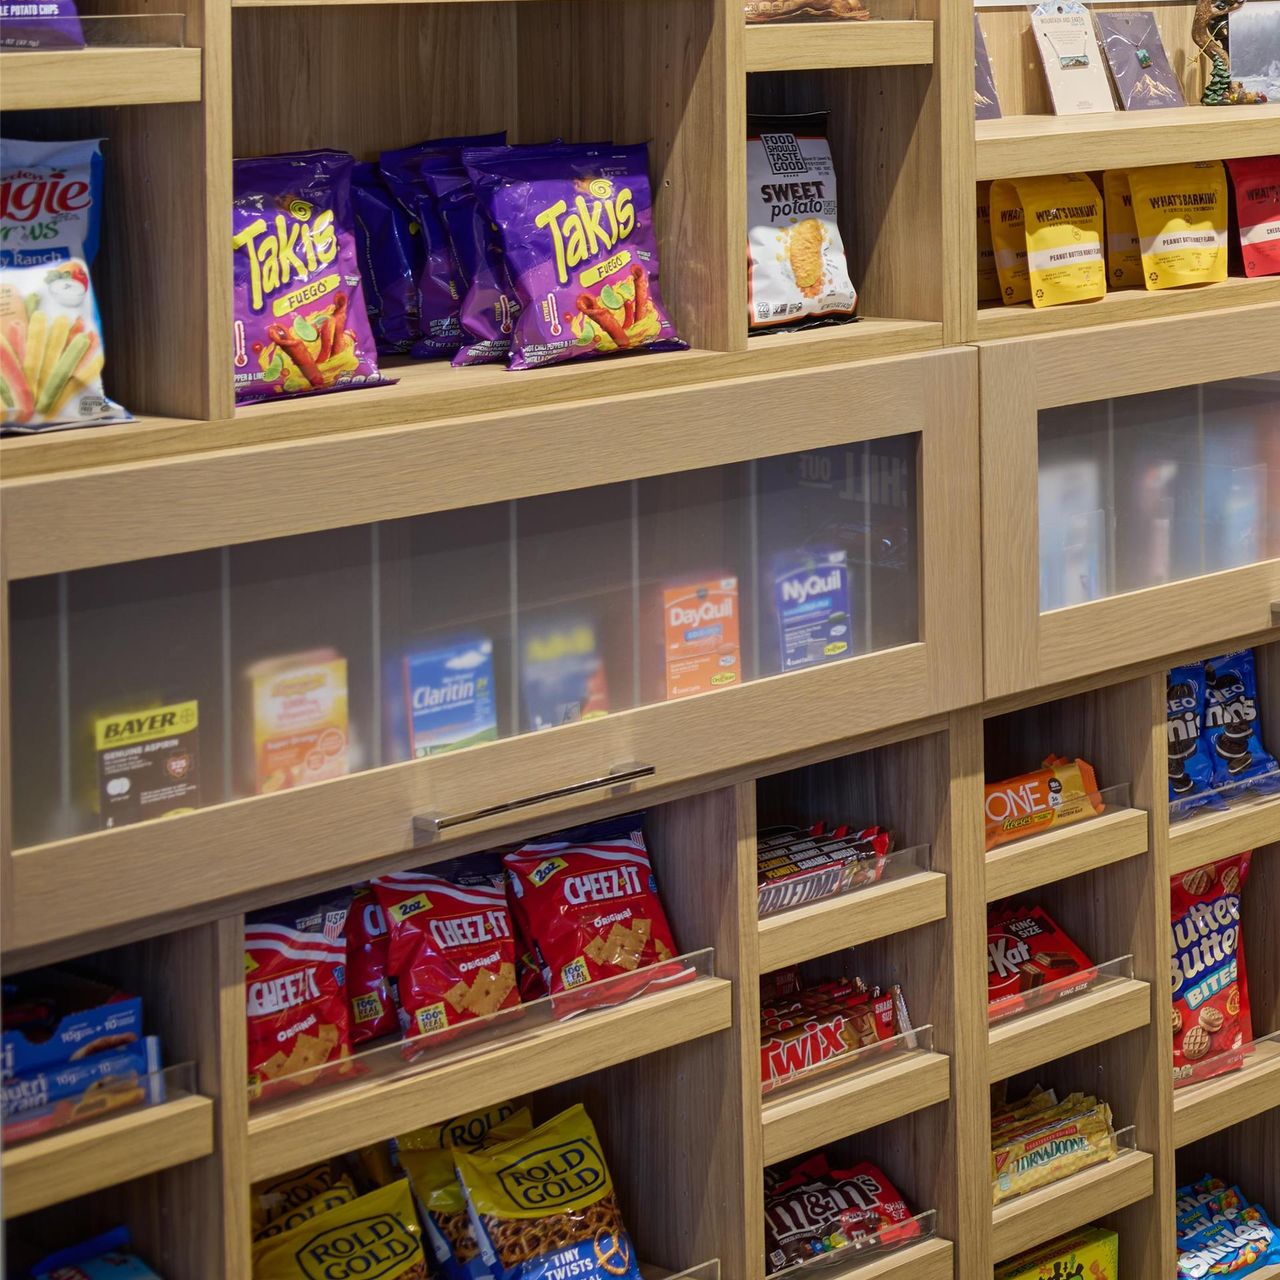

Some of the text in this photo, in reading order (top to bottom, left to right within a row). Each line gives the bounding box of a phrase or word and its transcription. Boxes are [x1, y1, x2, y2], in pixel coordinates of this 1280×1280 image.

[10, 4, 59, 17] POTATO CHIPS
[764, 135, 795, 146] FOOD
[767, 144, 798, 153] SHOULD
[770, 152, 801, 162] TASTE
[773, 161, 806, 172] GOOD
[760, 180, 826, 204] SWEET
[771, 198, 823, 222] potato
[533, 187, 637, 283] Takis
[1162, 236, 1181, 246] PEANUT
[13, 251, 62, 266] Ranch
[231, 209, 338, 310] Takis
[596, 257, 624, 280] FUEGO
[1050, 252, 1068, 262] PEANUT
[286, 282, 327, 309] FUEGO
[782, 571, 842, 603] NyQuil
[670, 599, 734, 627] DayQuil
[412, 681, 475, 711] Claritin
[104, 711, 176, 741] BAYER
[103, 738, 179, 761] GENUINE ASPIRIN
[985, 780, 1047, 822] ONE
[325, 910, 346, 922] USA
[1009, 918, 1036, 933] KING
[1018, 925, 1043, 939] SIZE
[1187, 961, 1239, 1009] BITES
[511, 1147, 585, 1188] ROLD
[522, 1166, 600, 1208] GOLD
[308, 1219, 395, 1266] ROLD
[1179, 1219, 1273, 1278] Skittles
[323, 1235, 410, 1280] GOLD
[545, 1259, 596, 1280] TWISTS
[553, 1246, 581, 1269] TINY
